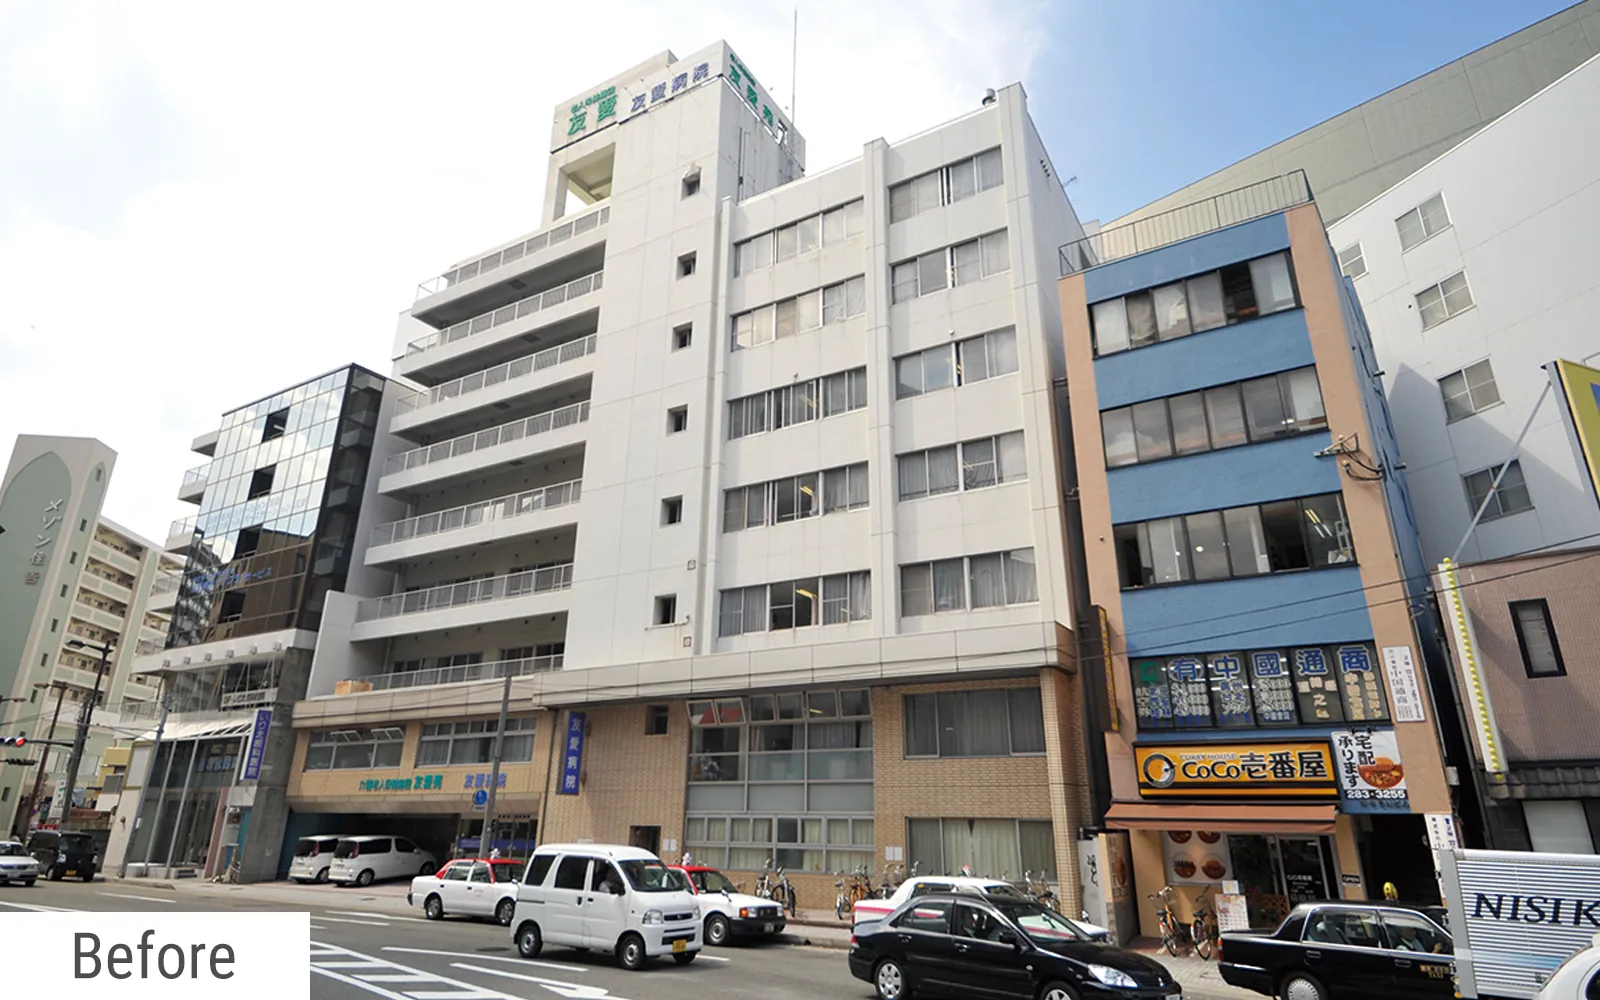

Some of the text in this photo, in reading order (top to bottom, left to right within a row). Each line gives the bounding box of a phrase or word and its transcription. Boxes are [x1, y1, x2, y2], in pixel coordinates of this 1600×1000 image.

[631, 62, 709, 112] 友愛病院
[565, 718, 581, 790] 友愛病院
[1179, 753, 1238, 762] CURRY HOUSE
[1339, 735, 1360, 788] 承ります
[1355, 735, 1376, 766] 宅配
